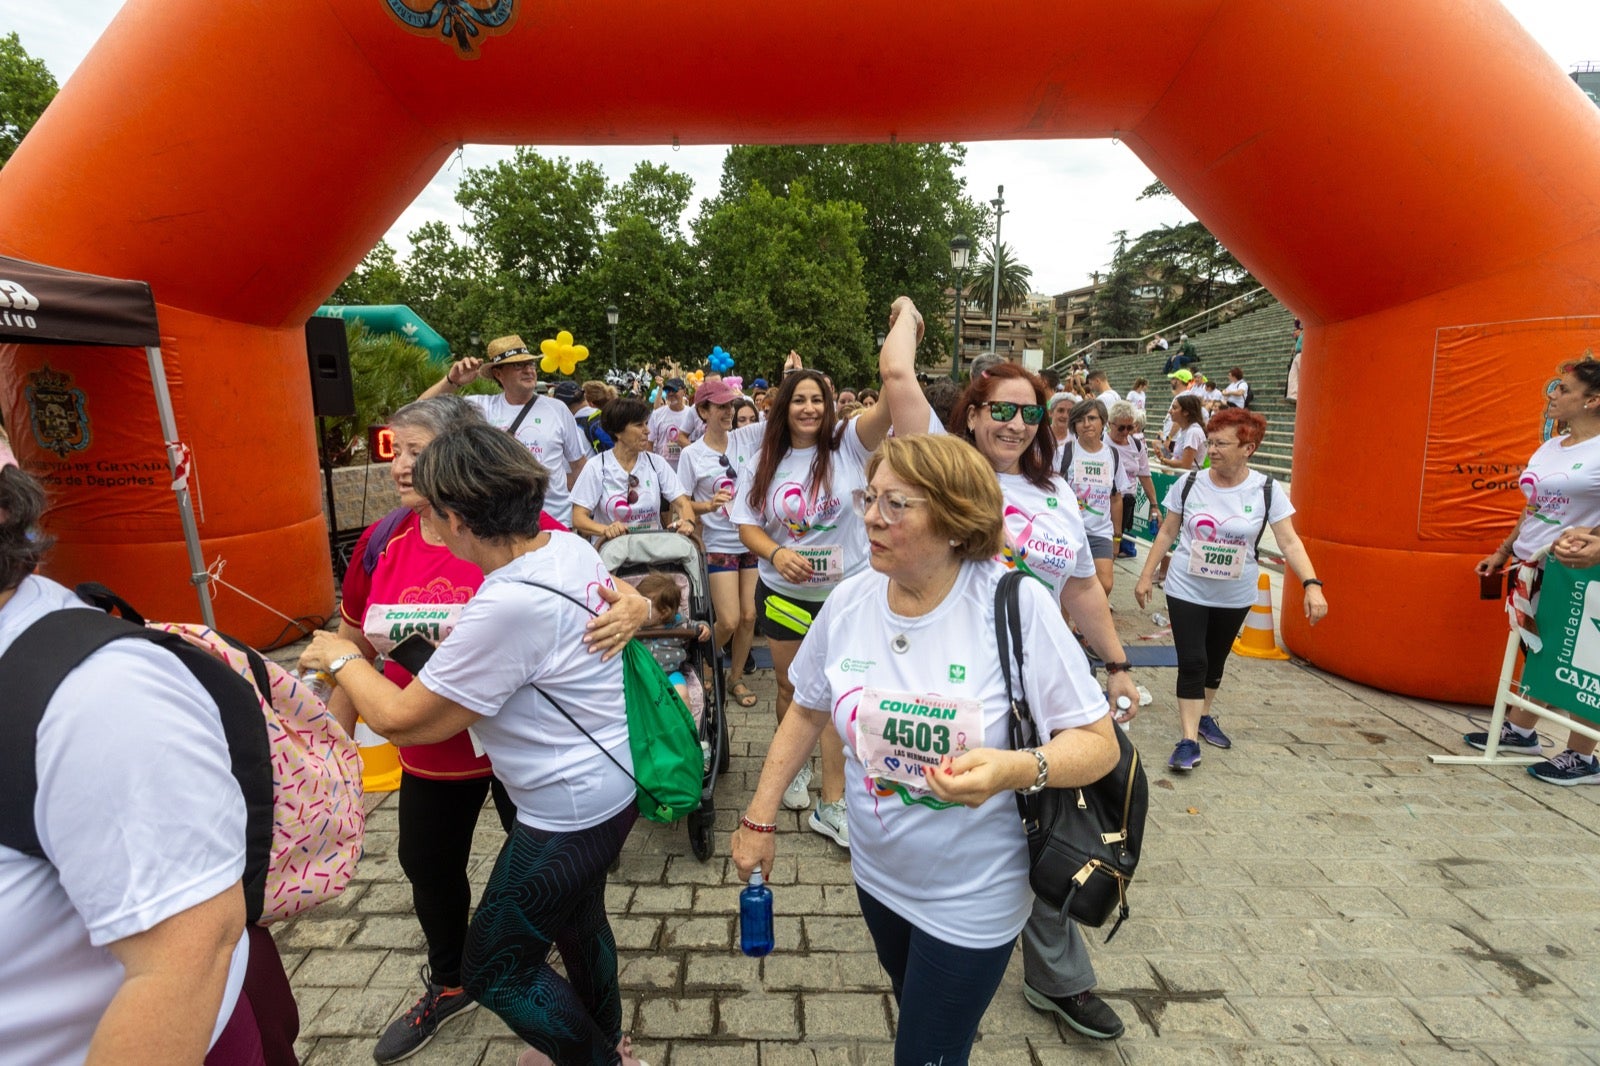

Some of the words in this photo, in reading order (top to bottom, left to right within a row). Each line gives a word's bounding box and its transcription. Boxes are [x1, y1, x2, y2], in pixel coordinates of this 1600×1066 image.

[1085, 466, 1101, 476] 1218
[86, 474, 154, 488] Deportes
[1202, 545, 1238, 554] COVIRAN
[1043, 554, 1067, 570] 5415
[1204, 552, 1233, 566] 1209
[385, 611, 449, 620] COVIRAN
[1557, 580, 1585, 665] fundación
[1555, 667, 1600, 695] CAJA
[879, 699, 957, 720] COVIRAN
[883, 717, 950, 755] 4503
[906, 751, 940, 766] HERMANAS
